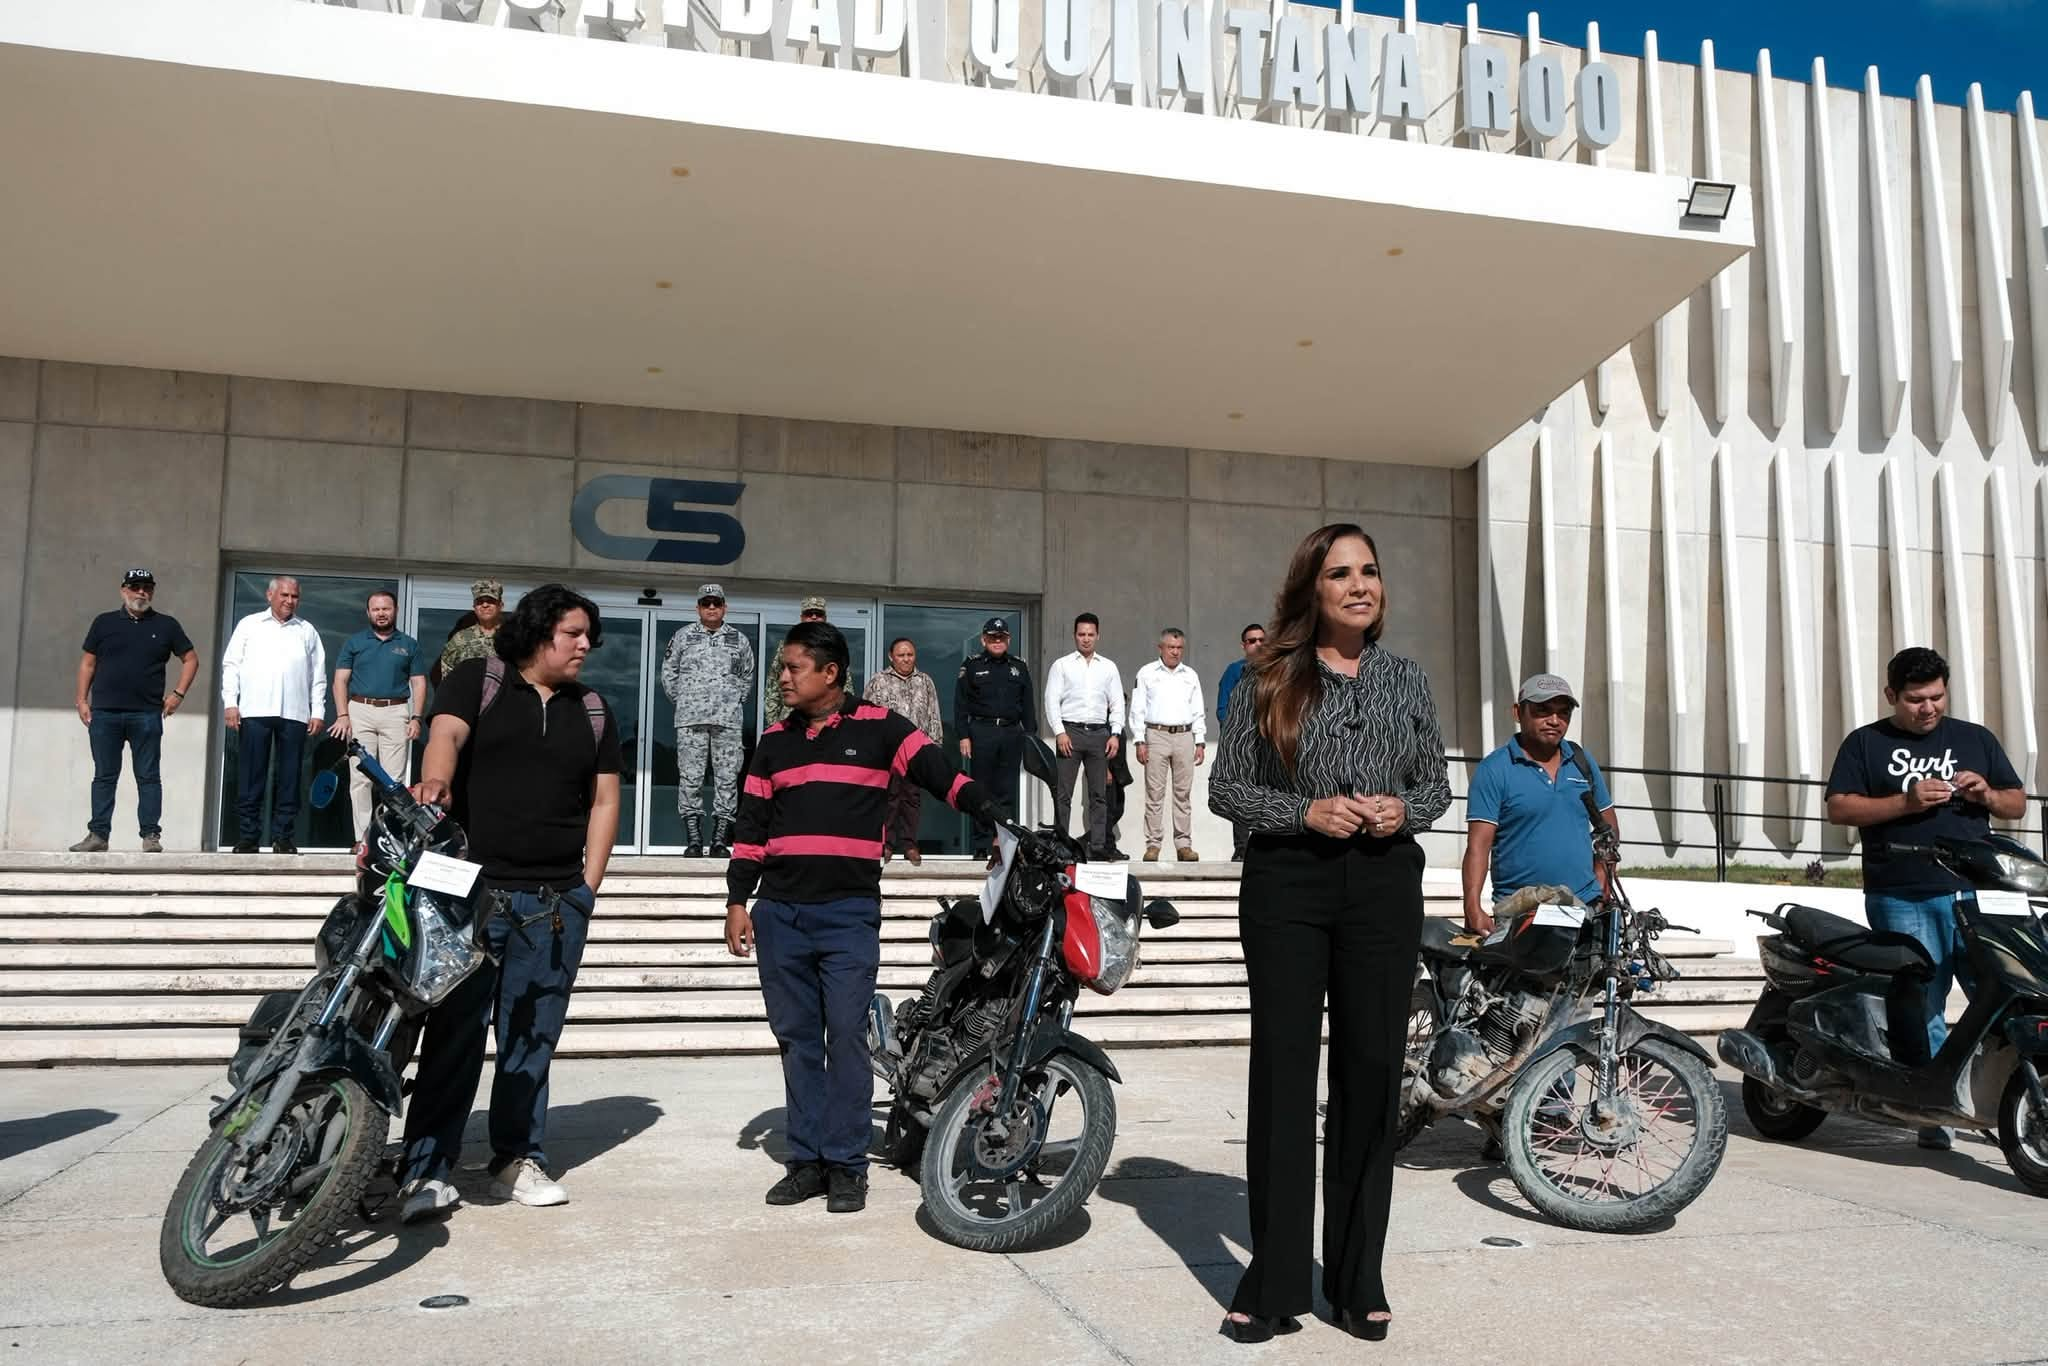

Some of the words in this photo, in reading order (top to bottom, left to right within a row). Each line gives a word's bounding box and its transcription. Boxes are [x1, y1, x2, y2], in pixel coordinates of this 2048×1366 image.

[968, 0, 1427, 126] QUINTANA
[1463, 43, 1621, 150] ROO
[1887, 748, 1958, 780] Surf
